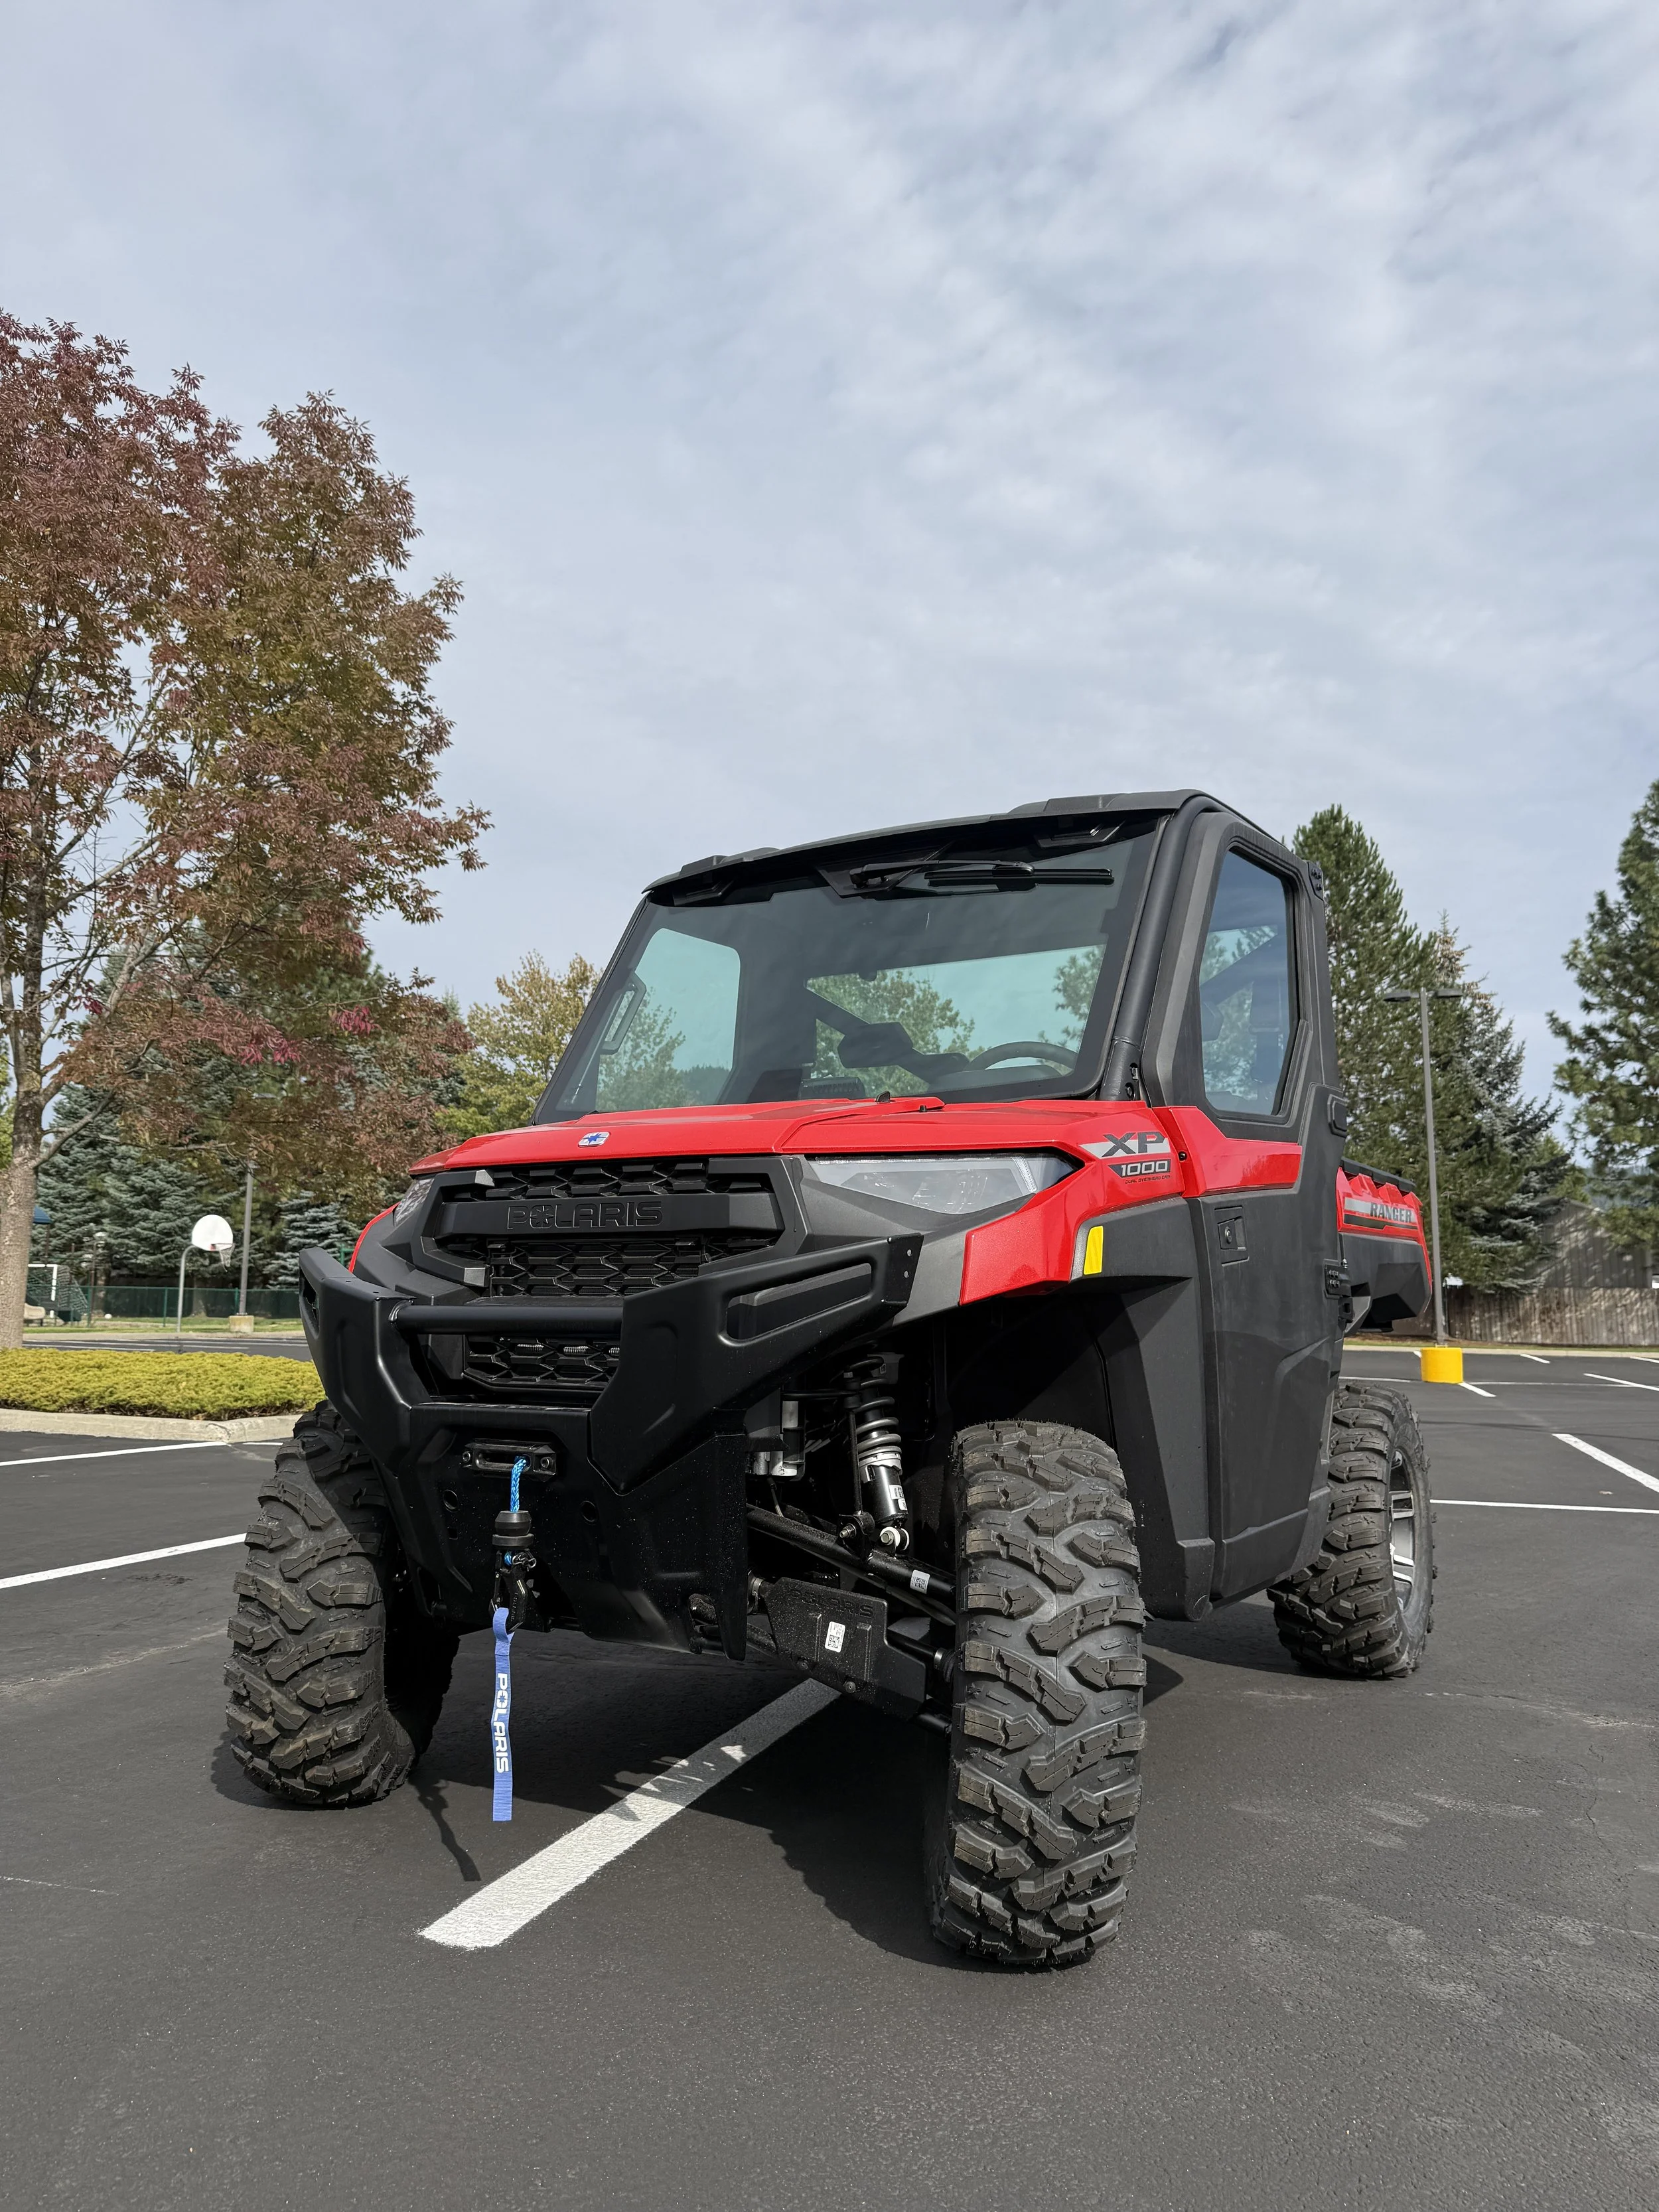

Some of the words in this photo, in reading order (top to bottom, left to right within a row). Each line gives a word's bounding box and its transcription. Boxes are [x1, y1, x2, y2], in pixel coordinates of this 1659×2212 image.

[1102, 1131, 1165, 1157] XP
[1121, 1160, 1169, 1177] 1000
[507, 1201, 663, 1230] POLARIS
[1370, 1202, 1411, 1222] RANGER
[494, 1673, 509, 1773] POLARIS
